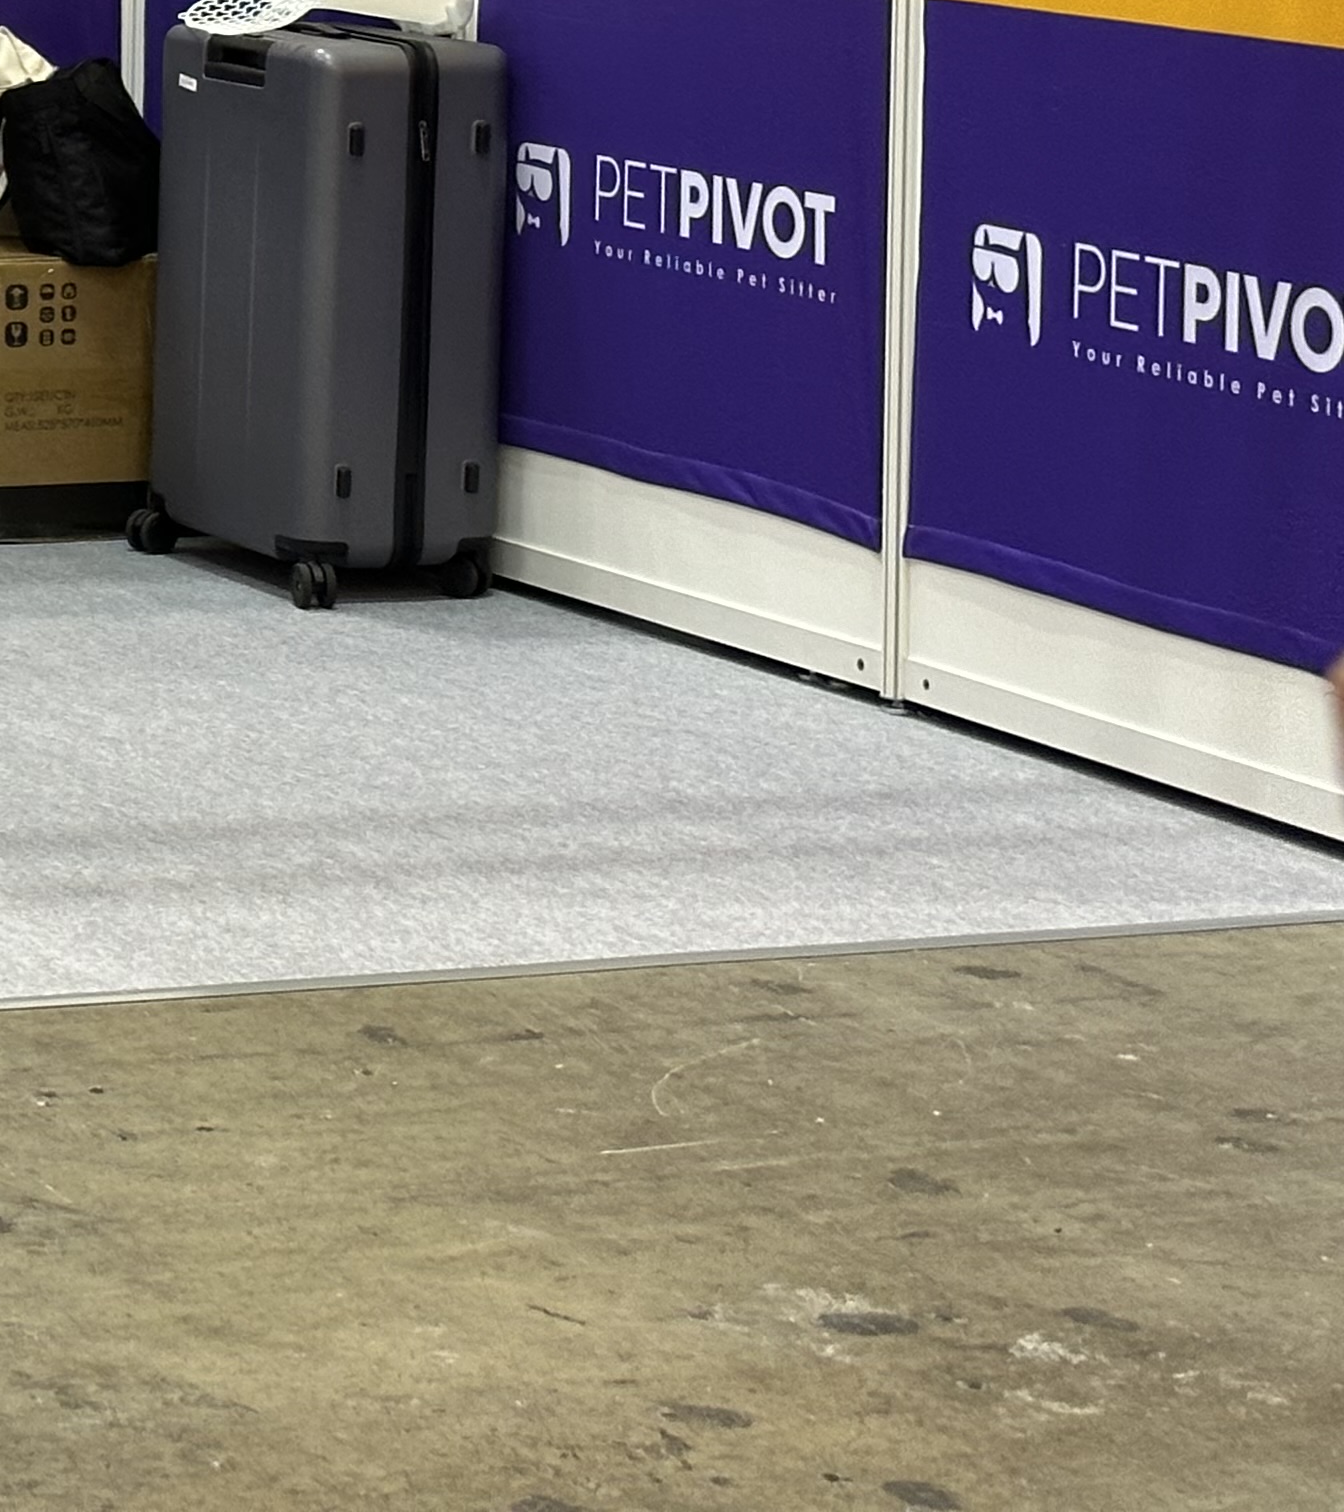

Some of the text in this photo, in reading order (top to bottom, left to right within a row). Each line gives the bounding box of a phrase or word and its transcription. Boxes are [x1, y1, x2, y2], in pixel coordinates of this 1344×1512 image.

[594, 154, 836, 266] PETPIVOT
[594, 240, 837, 305] Your Reliable Pet Sitter
[1072, 242, 1344, 374] PETPIVO
[1072, 340, 1123, 369] Your
[1136, 355, 1241, 396] Reliable
[1256, 381, 1295, 408] Pet
